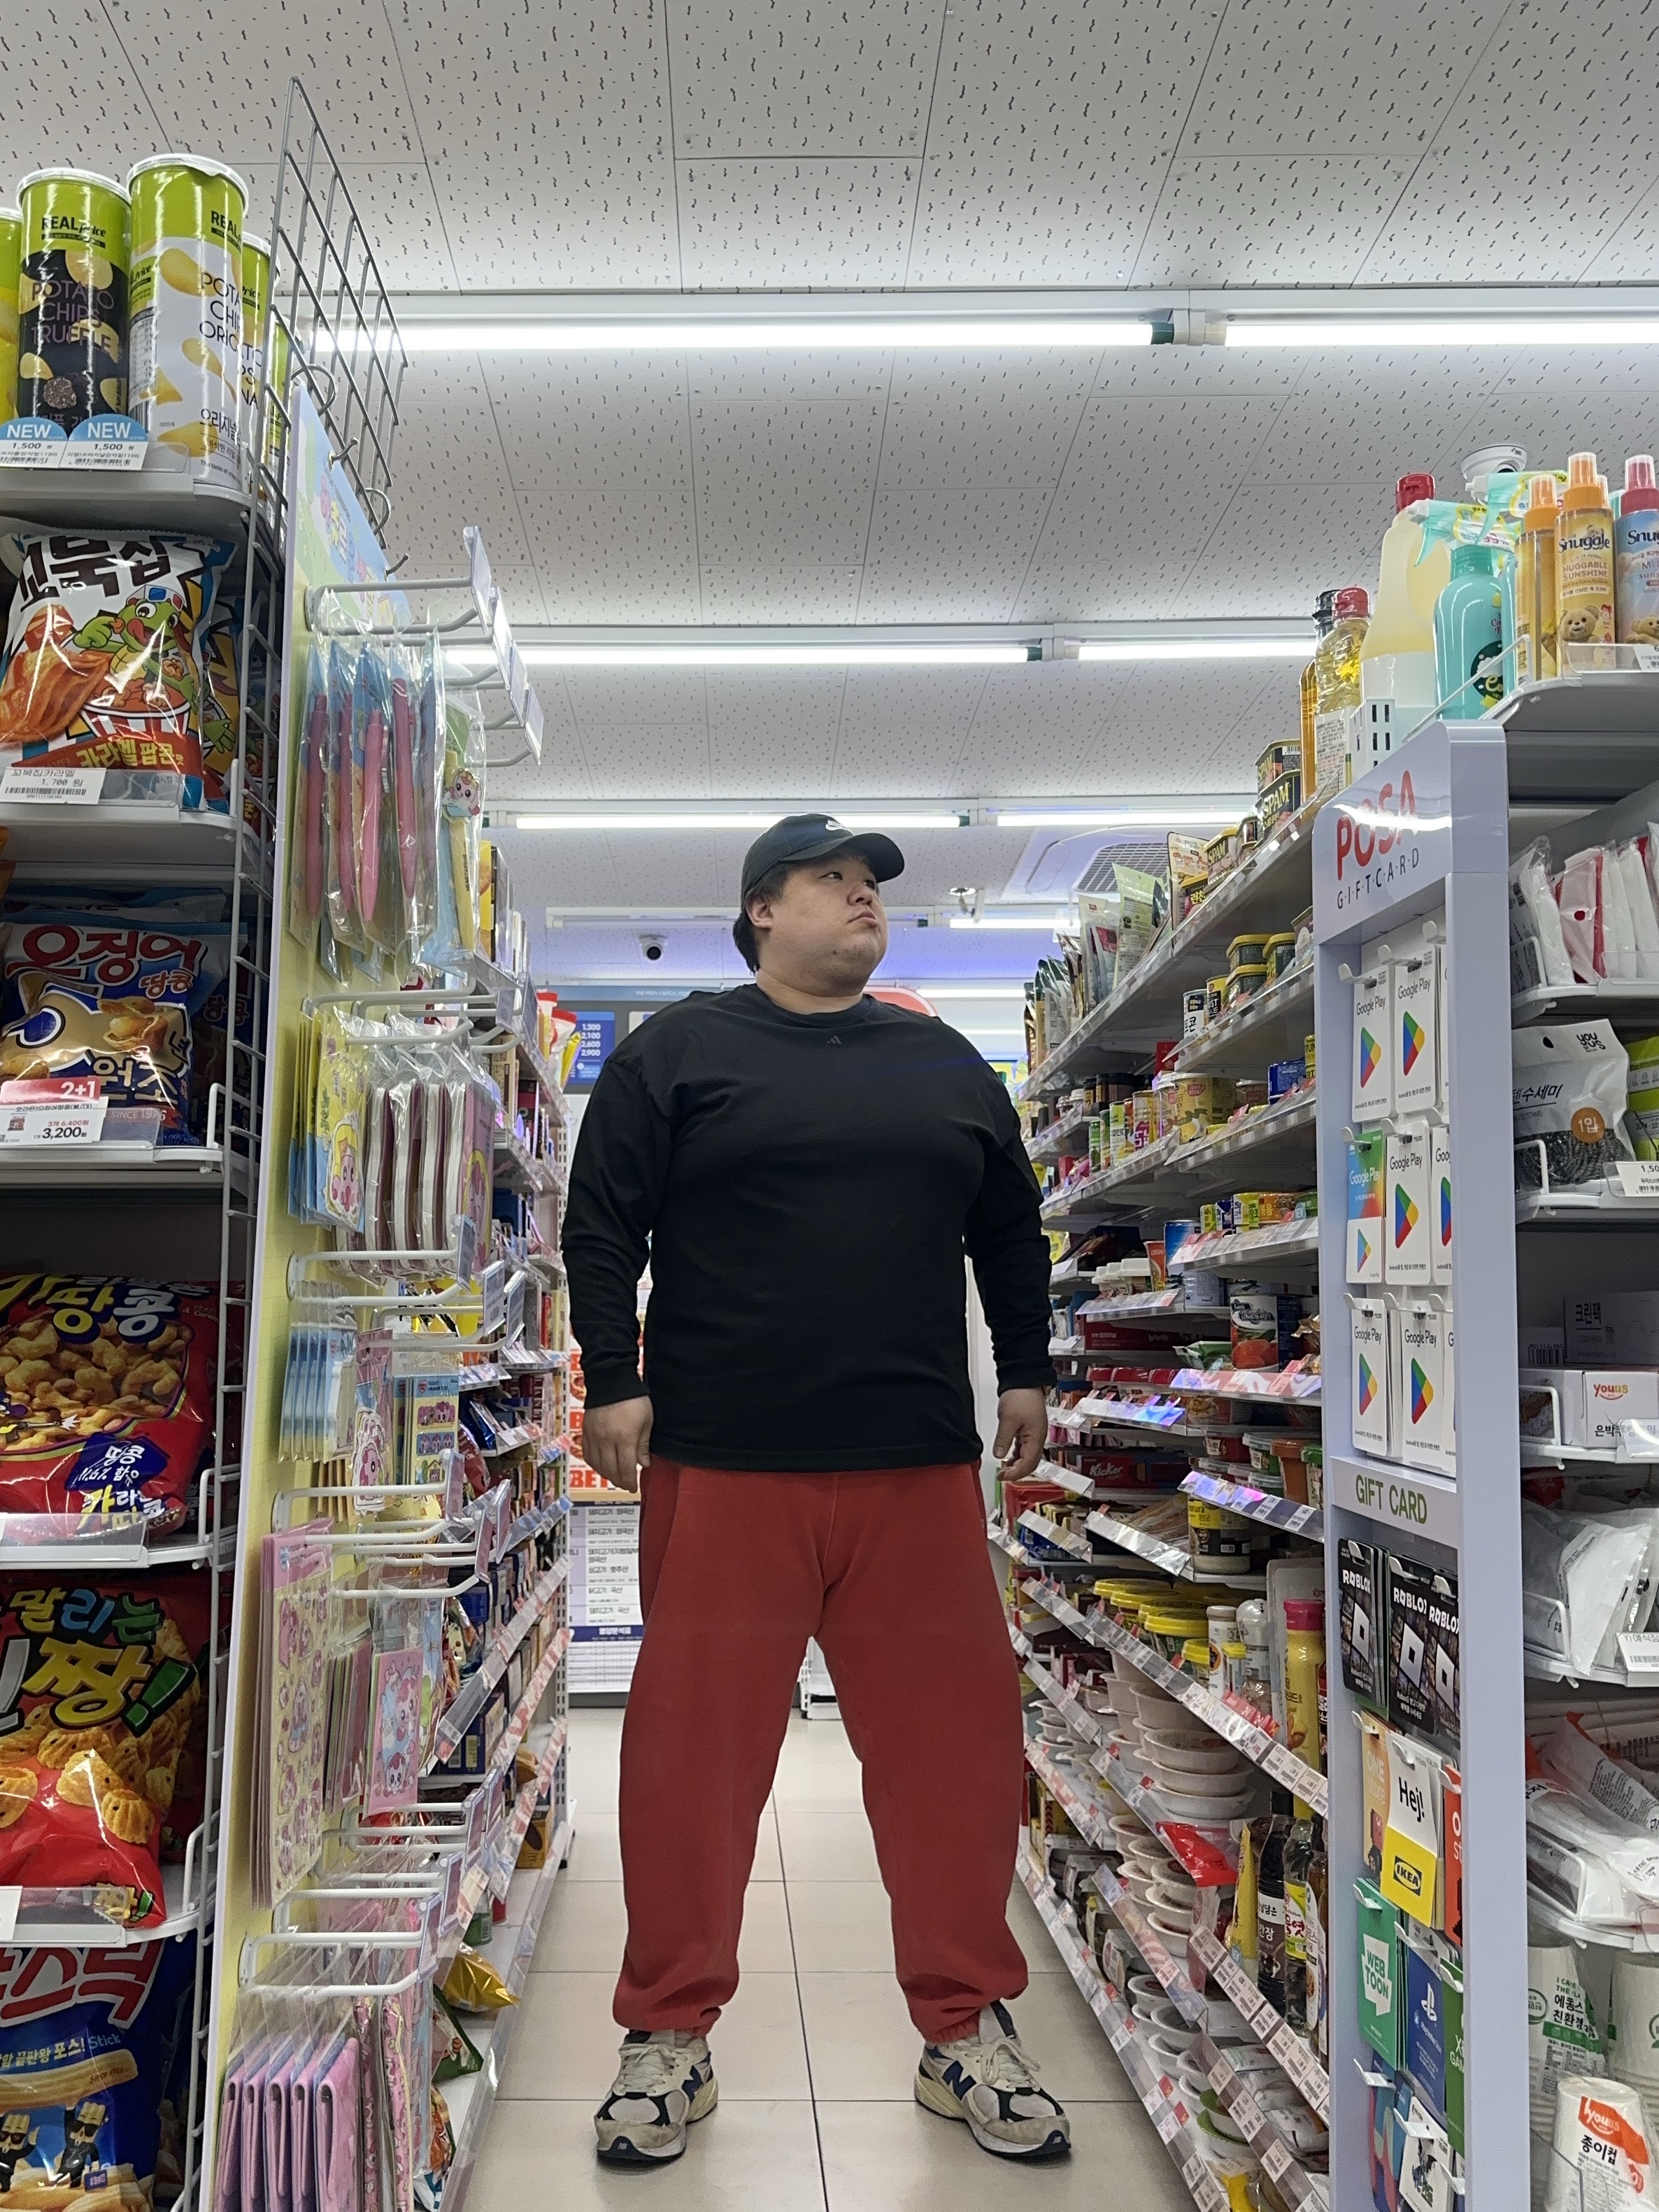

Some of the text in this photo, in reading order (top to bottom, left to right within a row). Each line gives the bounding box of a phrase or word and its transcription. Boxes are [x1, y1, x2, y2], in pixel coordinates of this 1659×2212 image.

[31, 323, 111, 355] TRUFFE
[7, 425, 52, 439] NEW
[87, 423, 131, 439] NEW
[1558, 532, 1610, 553] Snuggle
[1562, 561, 1608, 574] HUGGABLE
[1562, 569, 1608, 582] SUNSHINE
[76, 739, 138, 767] 카라멜
[140, 742, 177, 767] 팝콘
[1263, 781, 1290, 819] SPAM
[1208, 839, 1226, 866] SPAM
[6, 925, 203, 984] 오징어
[139, 970, 194, 999] 땅콩
[1398, 977, 1432, 1000] Google Play
[1356, 994, 1386, 1016] Google Play
[60, 1081, 96, 1099] 2+1
[110, 1110, 138, 1119] SINCE
[1390, 1153, 1423, 1172] Google Play
[1349, 1167, 1381, 1187] Google Play
[46, 1286, 176, 1338] 땅콩
[1575, 1301, 1602, 1324] 크린팩
[1354, 1326, 1382, 1345] Google Play
[1404, 1328, 1425, 1347] Google
[1425, 1330, 1437, 1348] Play
[1593, 1383, 1629, 1398] youus
[104, 1445, 145, 1467] 땅콩
[113, 1466, 140, 1487] 함유
[1355, 1474, 1427, 1525] GIFT CARD
[10, 1588, 161, 1643] 말리는
[1399, 1776, 1425, 1823] Hej!
[1396, 1864, 1420, 1887] IKEA
[1367, 1949, 1386, 1979] WEB
[0, 1941, 163, 2022] 스틱
[1365, 1965, 1389, 2000] TOON
[1553, 2008, 1583, 2030] 친환경
[54, 2037, 86, 2060] 포스!
[89, 2033, 121, 2050] Stick
[1580, 2134, 1618, 2166] 종이컵
